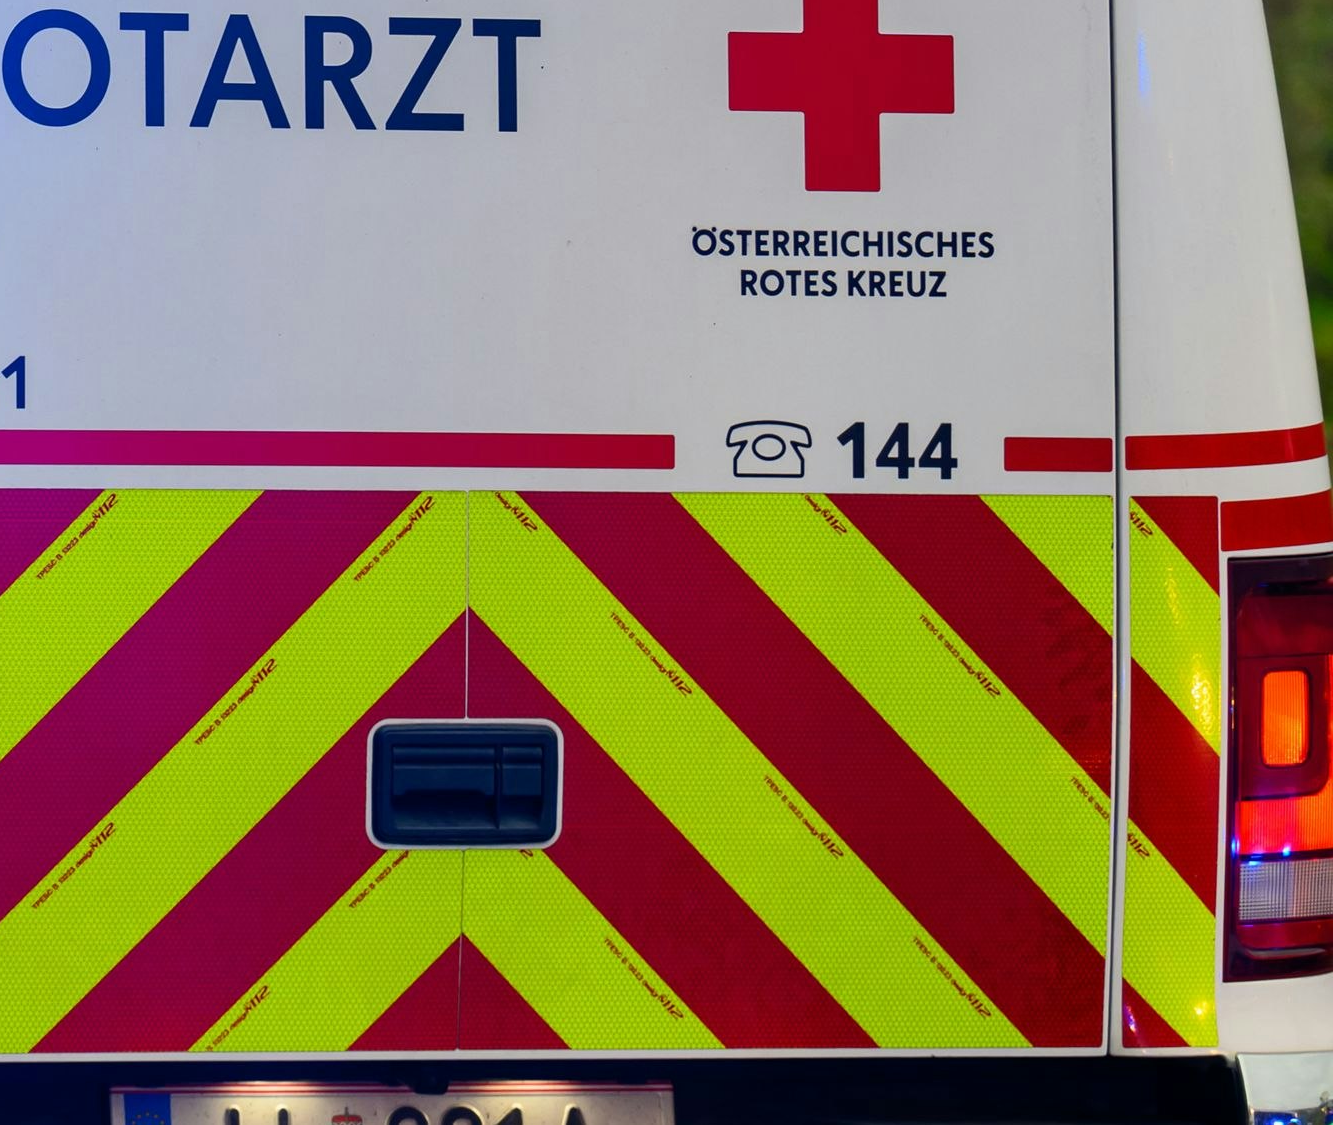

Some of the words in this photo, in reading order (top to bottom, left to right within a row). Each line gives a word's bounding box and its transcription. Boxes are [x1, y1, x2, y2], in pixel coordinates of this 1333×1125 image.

[692, 227, 994, 258] ÖSTERREICHISCHES
[741, 270, 837, 296] ROTES
[848, 271, 946, 297] KREUZ
[837, 422, 957, 479] 144
